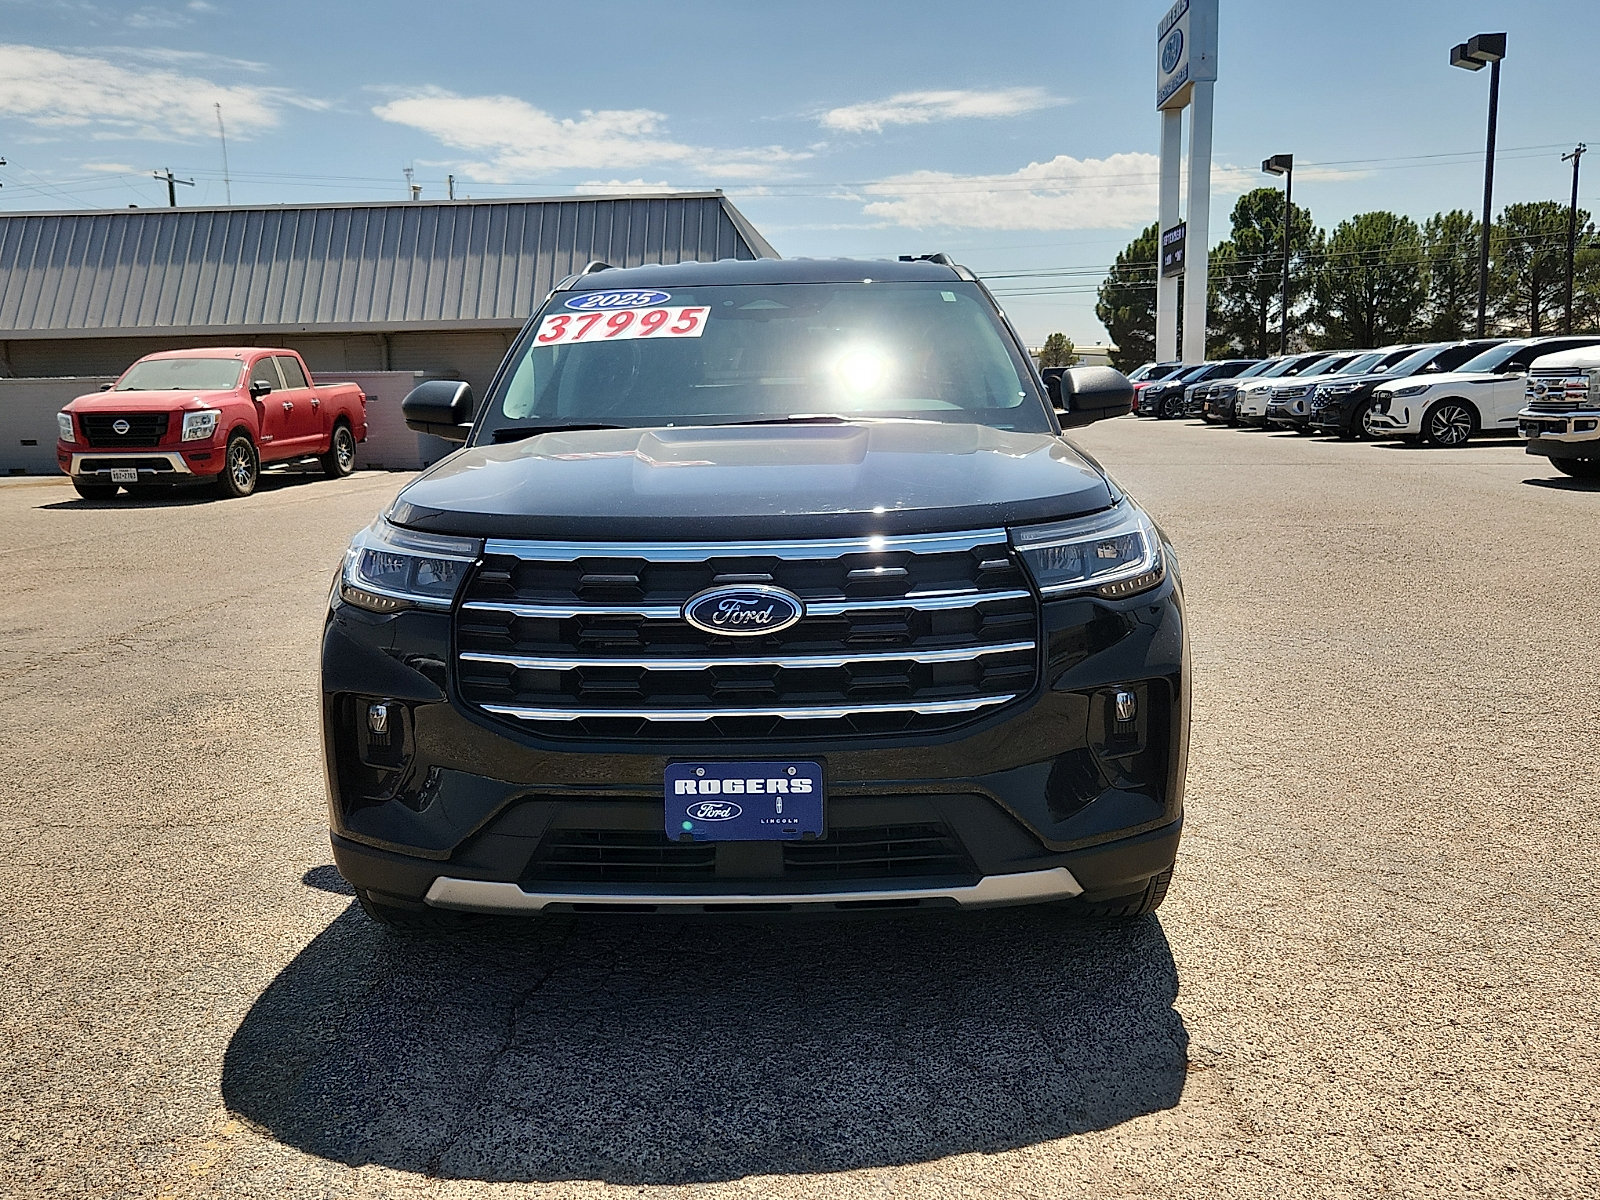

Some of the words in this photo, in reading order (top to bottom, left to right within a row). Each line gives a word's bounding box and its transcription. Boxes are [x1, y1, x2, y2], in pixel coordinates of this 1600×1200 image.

[579, 292, 658, 309] 2025
[538, 308, 705, 343] 37995
[712, 598, 775, 625] Ford
[674, 778, 813, 795] ROGERS
[696, 803, 732, 818] Ford
